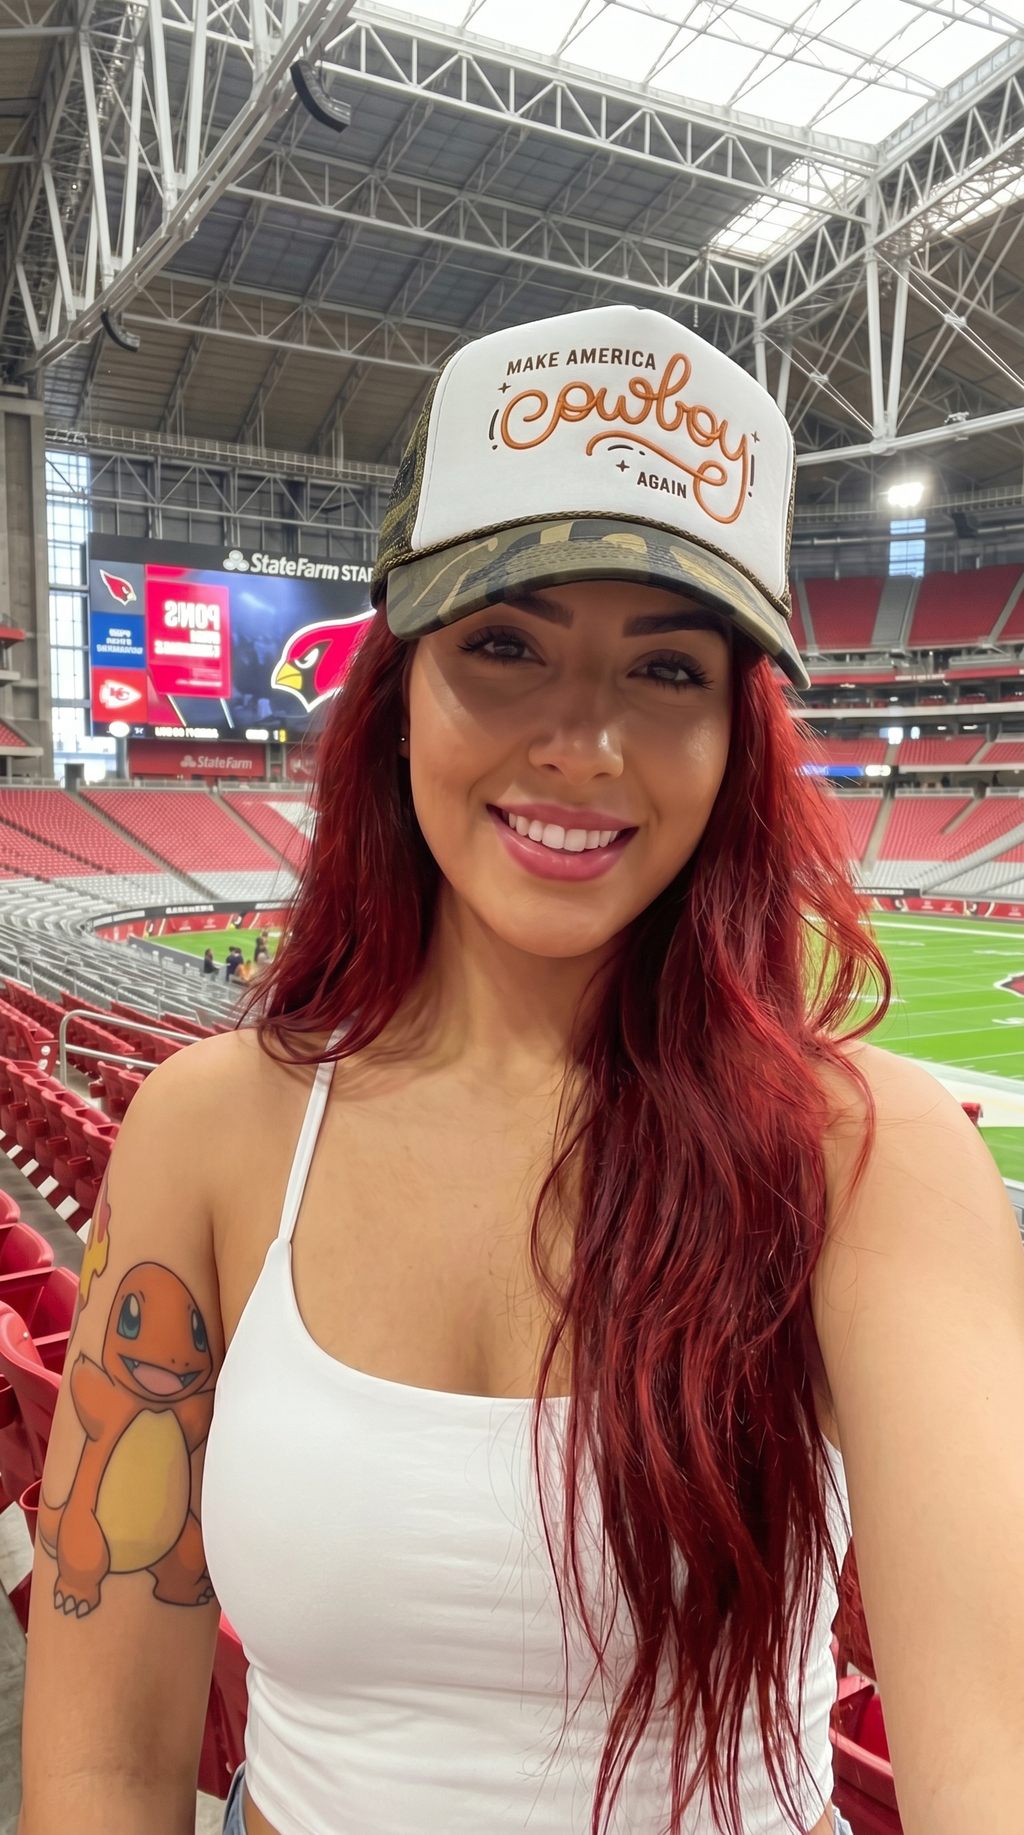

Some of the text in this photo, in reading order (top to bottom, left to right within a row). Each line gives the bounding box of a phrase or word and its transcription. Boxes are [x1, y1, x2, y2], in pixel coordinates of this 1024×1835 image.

[506, 347, 656, 376] MAKE AMERICA
[636, 471, 687, 499] AGAIN
